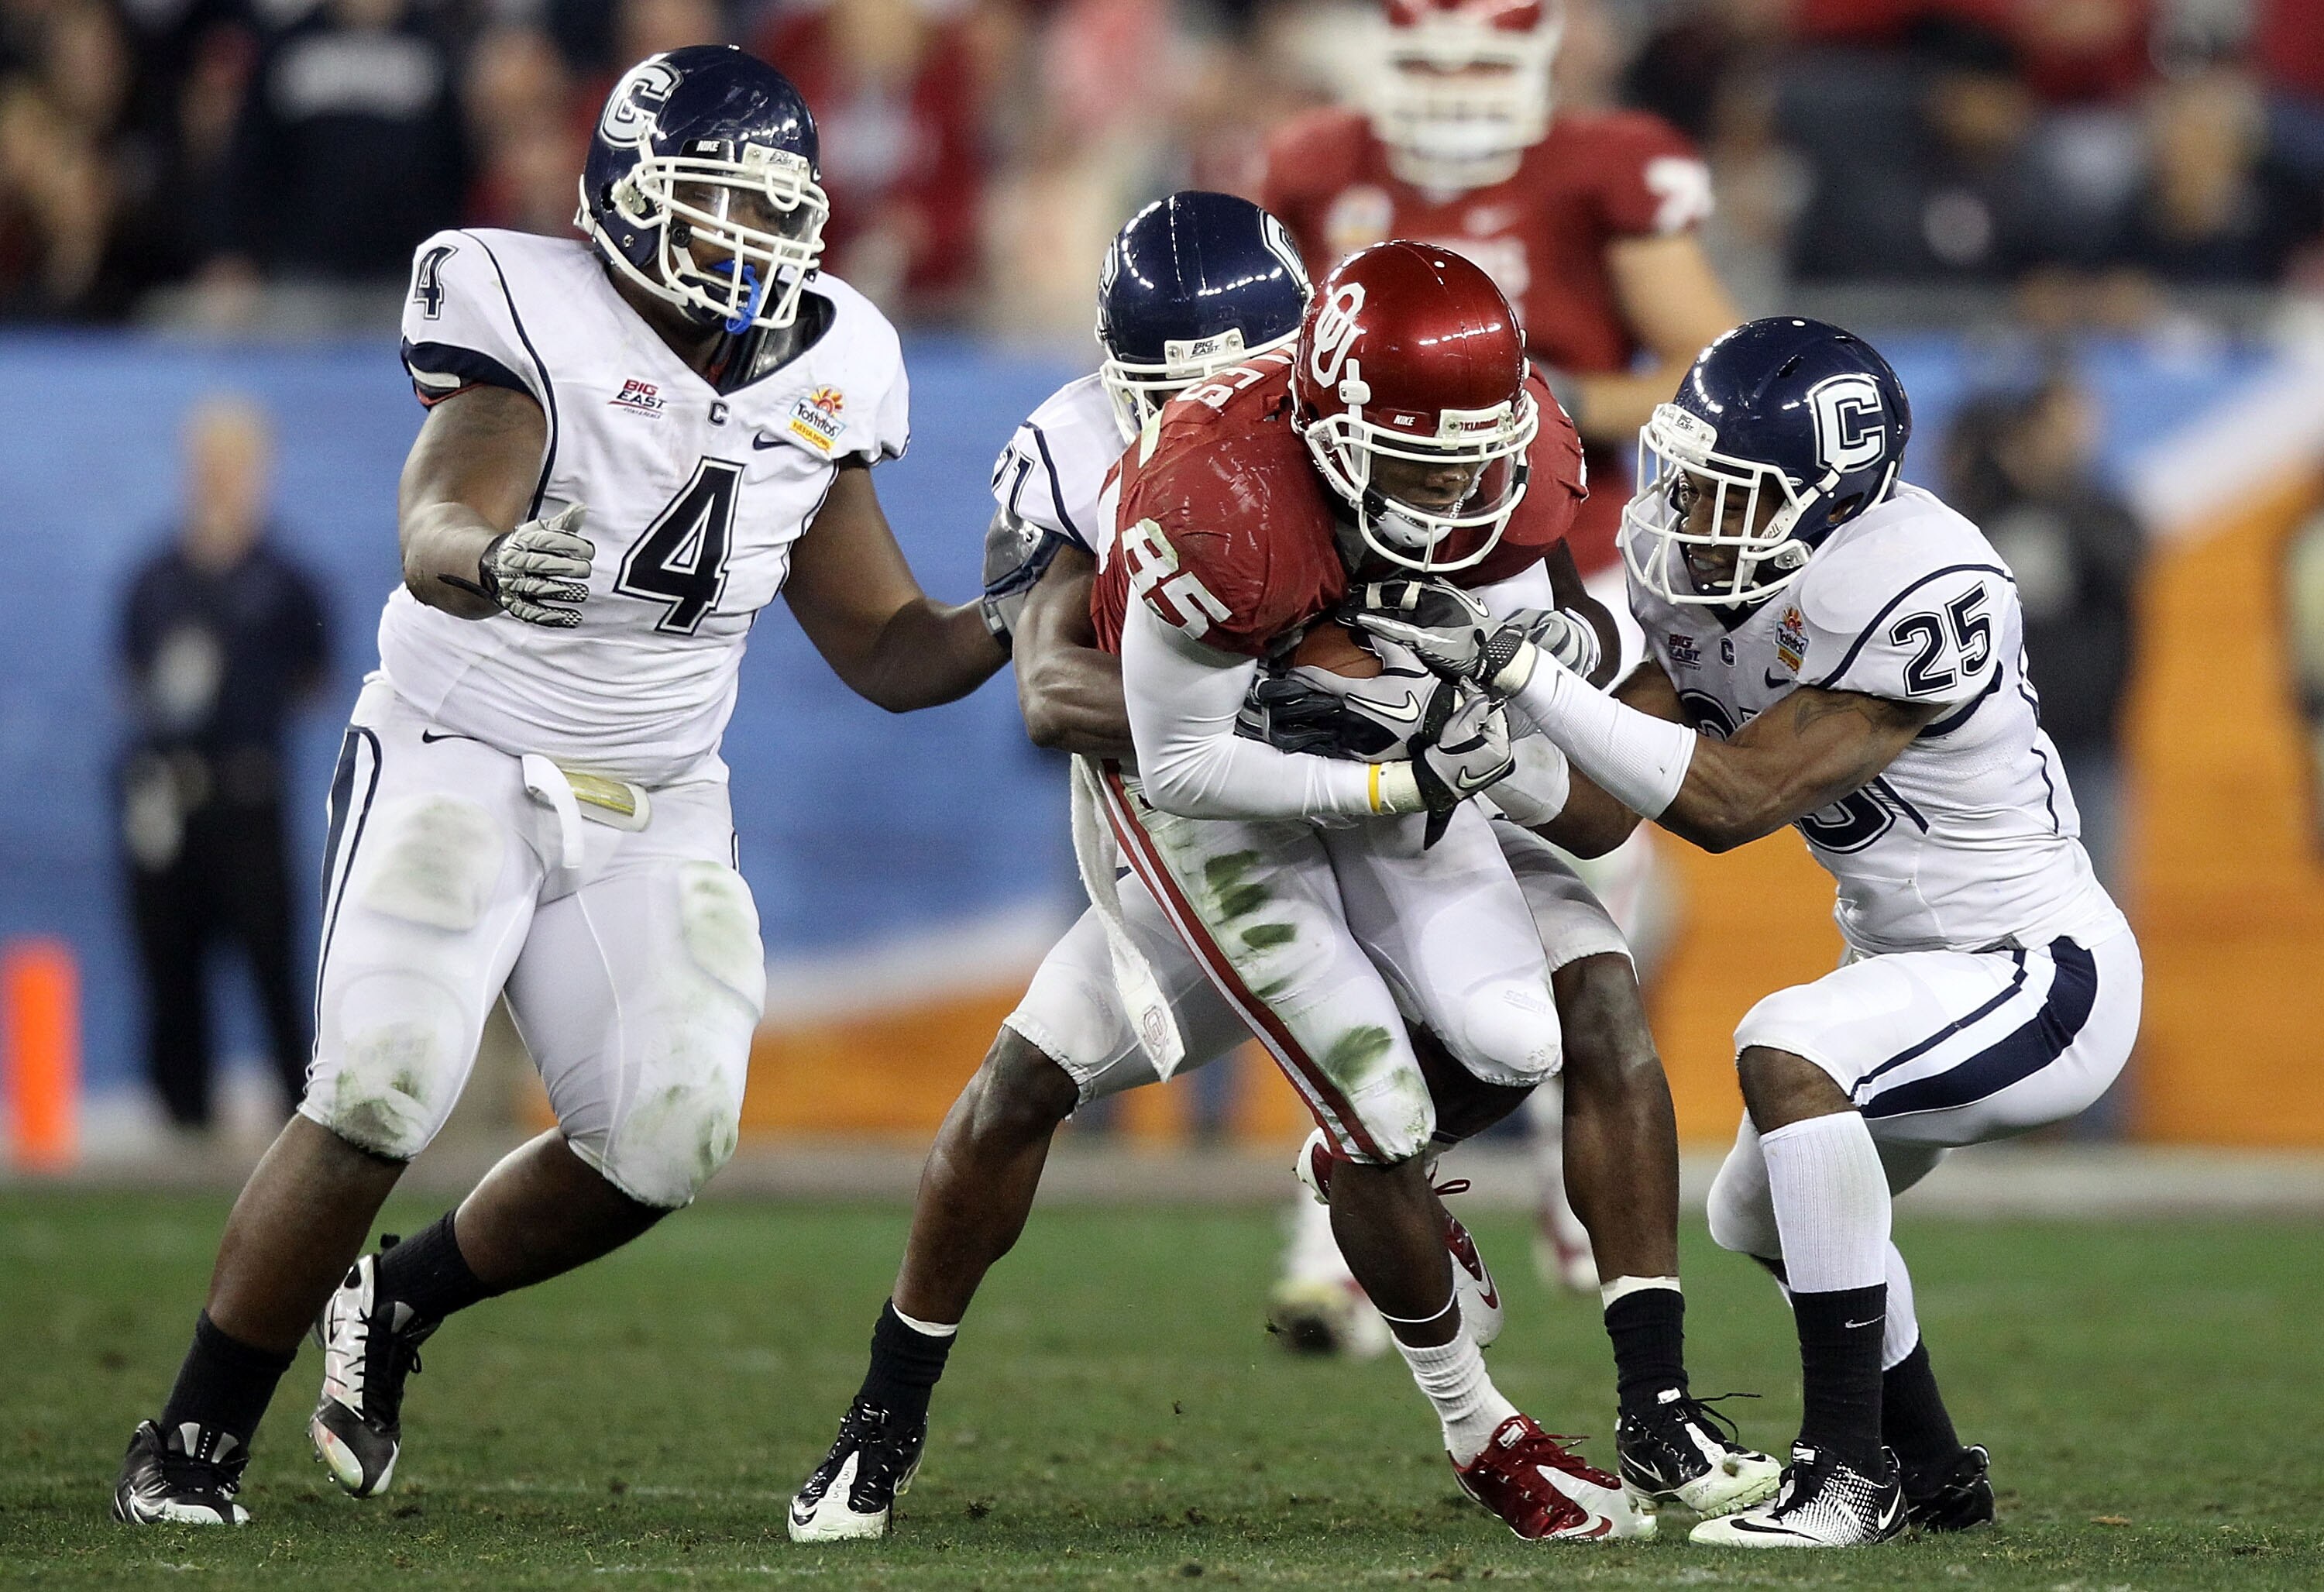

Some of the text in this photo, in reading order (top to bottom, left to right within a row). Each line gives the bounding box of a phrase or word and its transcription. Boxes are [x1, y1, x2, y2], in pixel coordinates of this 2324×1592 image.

[600, 61, 683, 149] C
[696, 140, 720, 152] NIKE
[413, 243, 459, 320] 4
[1194, 339, 1214, 349] BIG
[1311, 282, 1366, 388] OU
[1191, 345, 1220, 356] EAST
[617, 390, 667, 410] EAST
[623, 378, 658, 396] BIG
[707, 399, 731, 427] C
[1394, 414, 1415, 426] NIKE
[1805, 373, 1886, 474] C
[612, 454, 747, 636] 4
[1121, 517, 1233, 641] 85
[1669, 633, 1694, 649] BIG
[1720, 638, 1737, 666] C
[1889, 580, 1992, 696] 25
